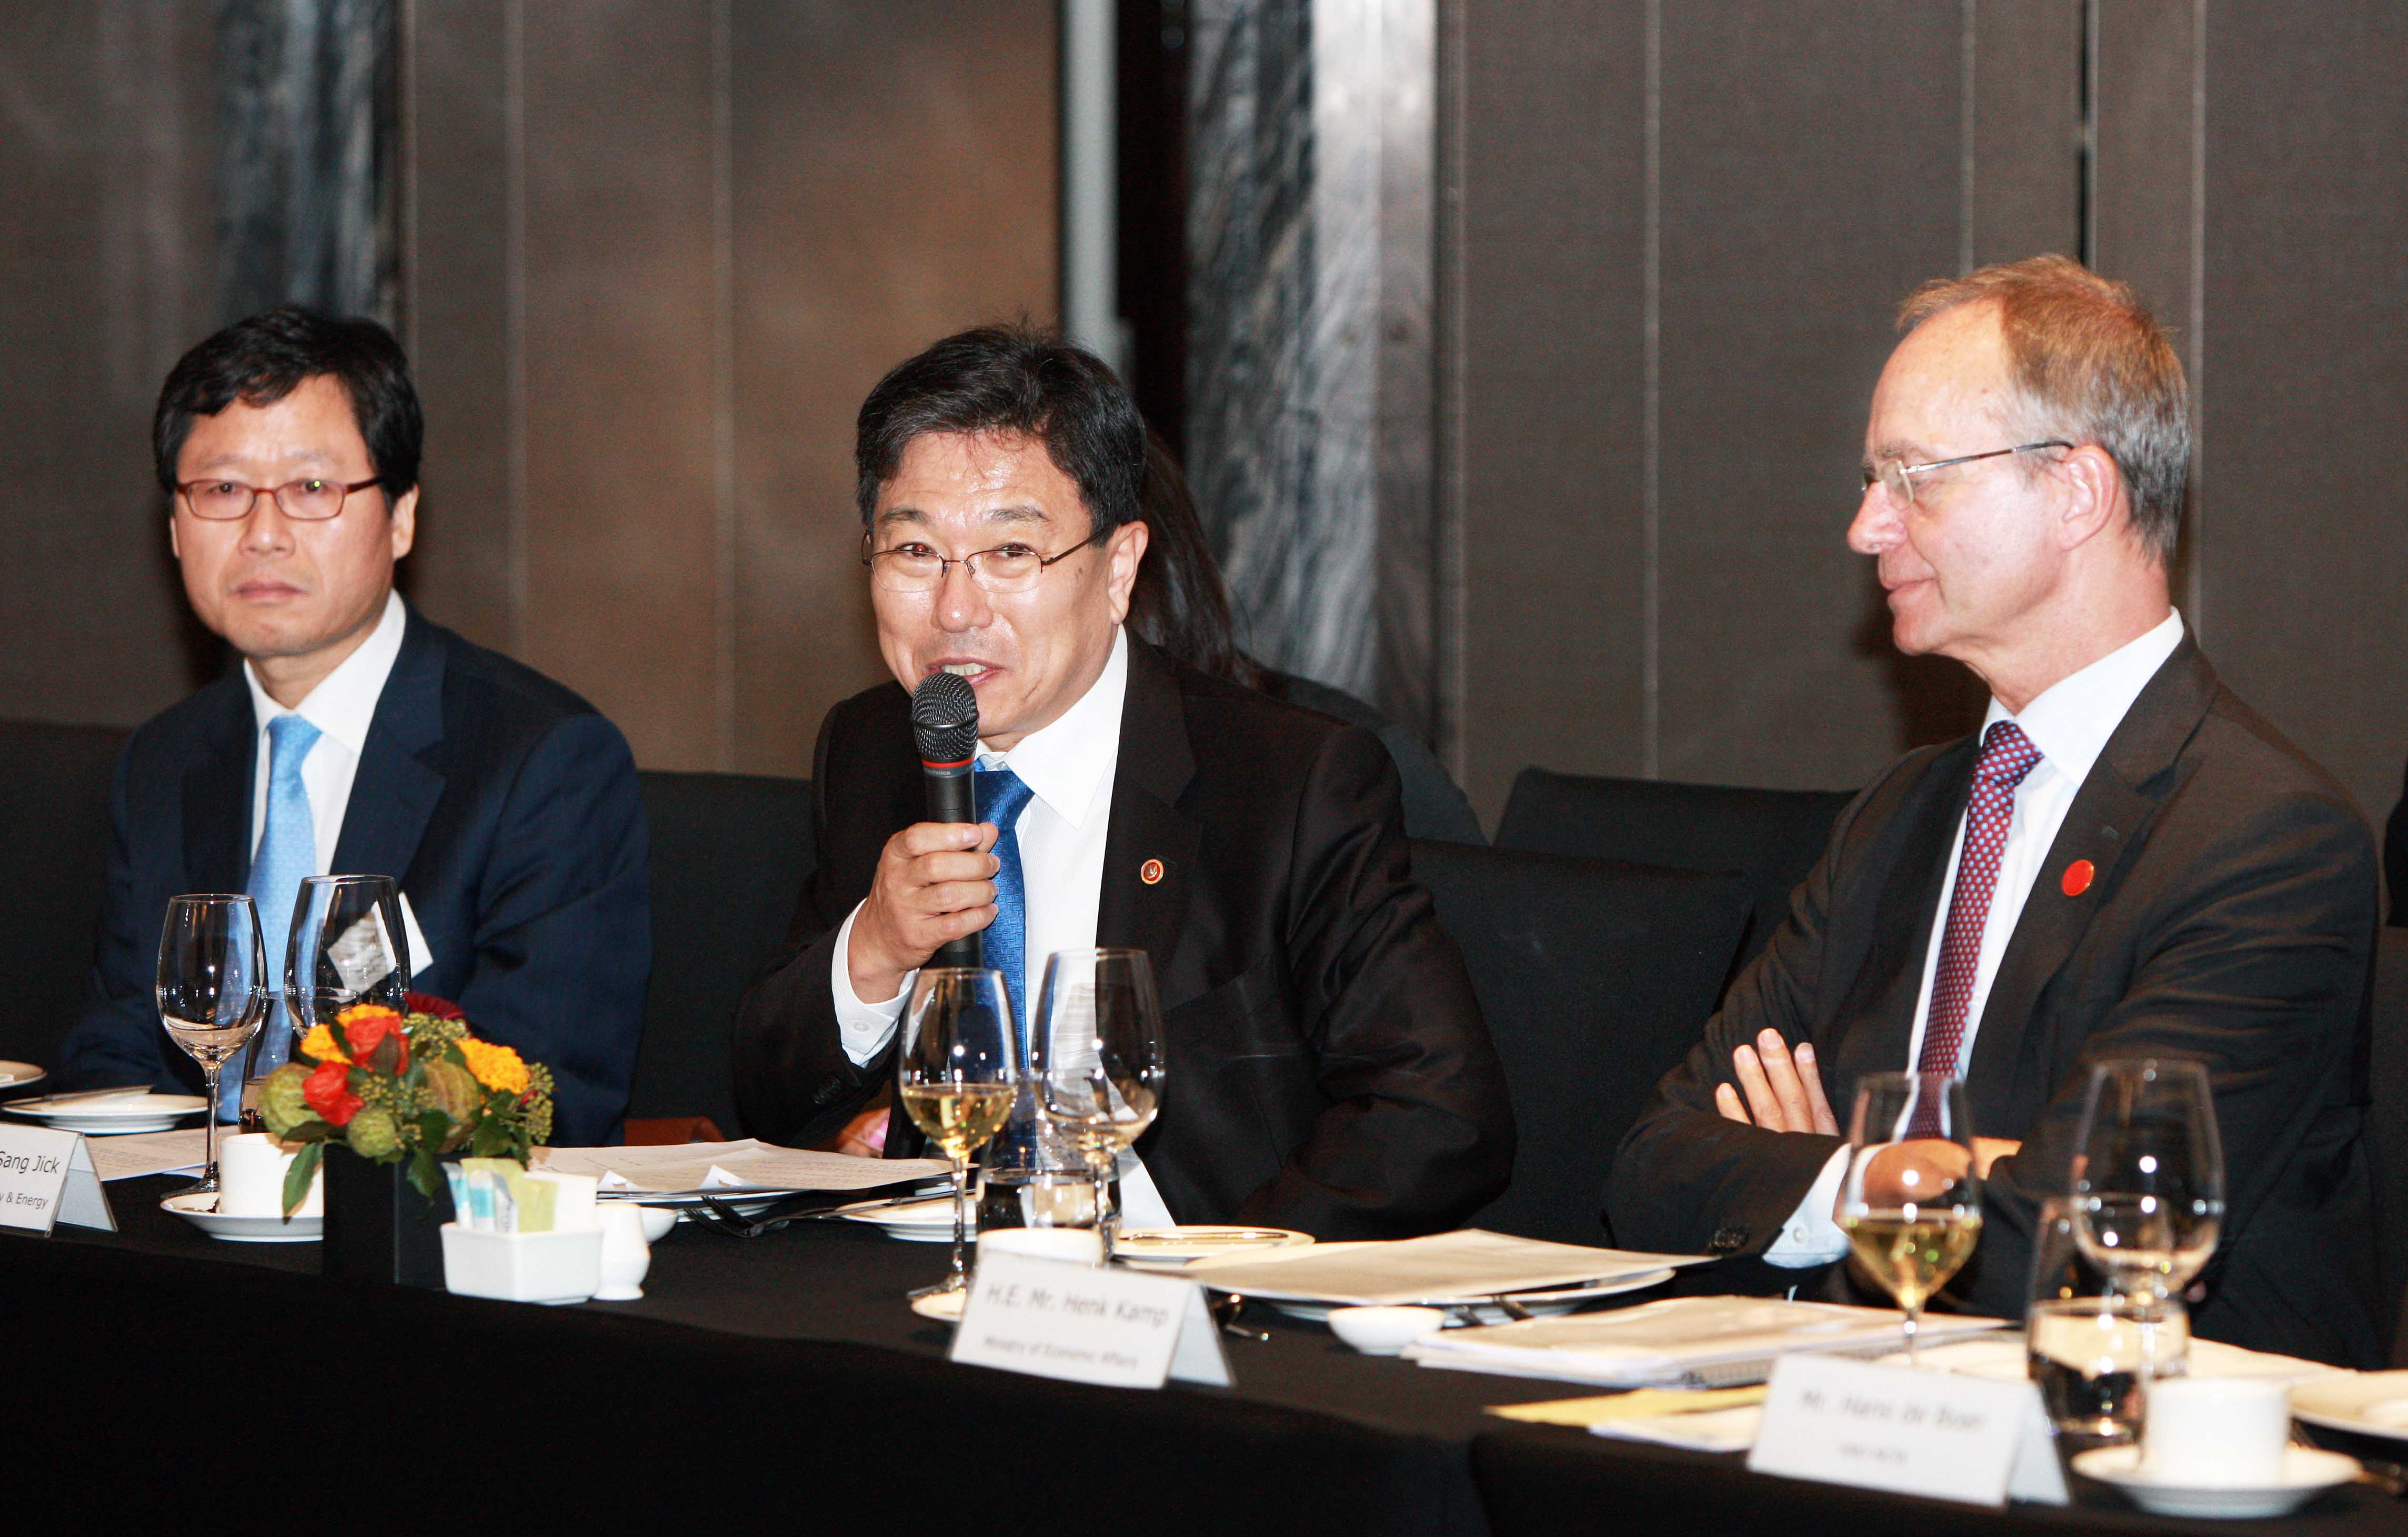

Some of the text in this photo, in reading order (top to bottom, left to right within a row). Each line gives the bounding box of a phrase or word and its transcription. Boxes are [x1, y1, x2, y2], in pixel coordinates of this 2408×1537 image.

[32, 1155, 60, 1174] Jick
[6, 1192, 13, 1203] &
[16, 1193, 49, 1210] Energy
[986, 1283, 1169, 1328] H.E. Mr. Henk Kamp
